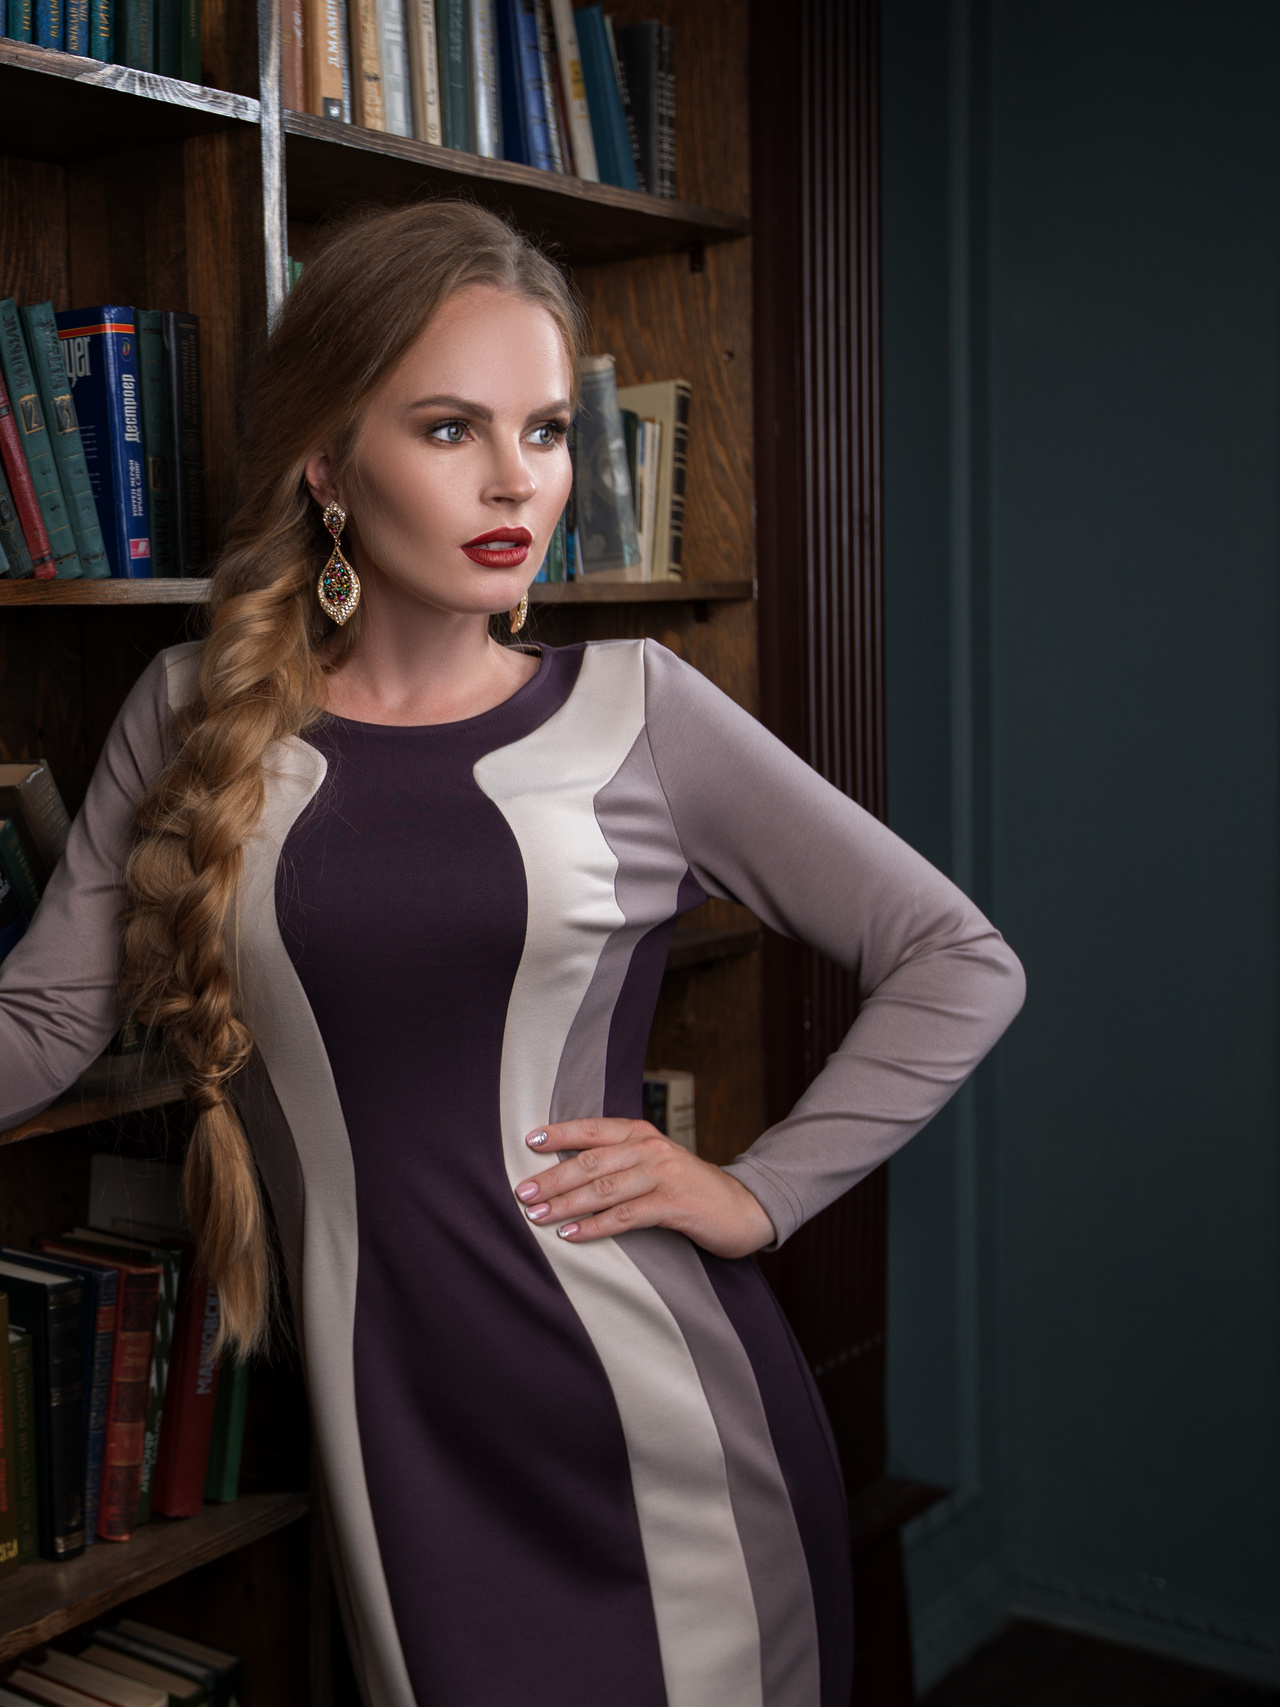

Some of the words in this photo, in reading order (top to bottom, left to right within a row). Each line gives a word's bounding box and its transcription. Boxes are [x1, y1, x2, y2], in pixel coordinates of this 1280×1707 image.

[2, 314, 31, 389] БАЛЬЗАК
[39, 316, 66, 389] БАЛЬЗАК
[25, 399, 38, 427] 2
[121, 373, 140, 443] Дестроер
[154, 499, 169, 567] БАЛЬЗАК
[16, 1372, 27, 1428] РОССИИ
[18, 1432, 31, 1497] ИСТОРИЯ
